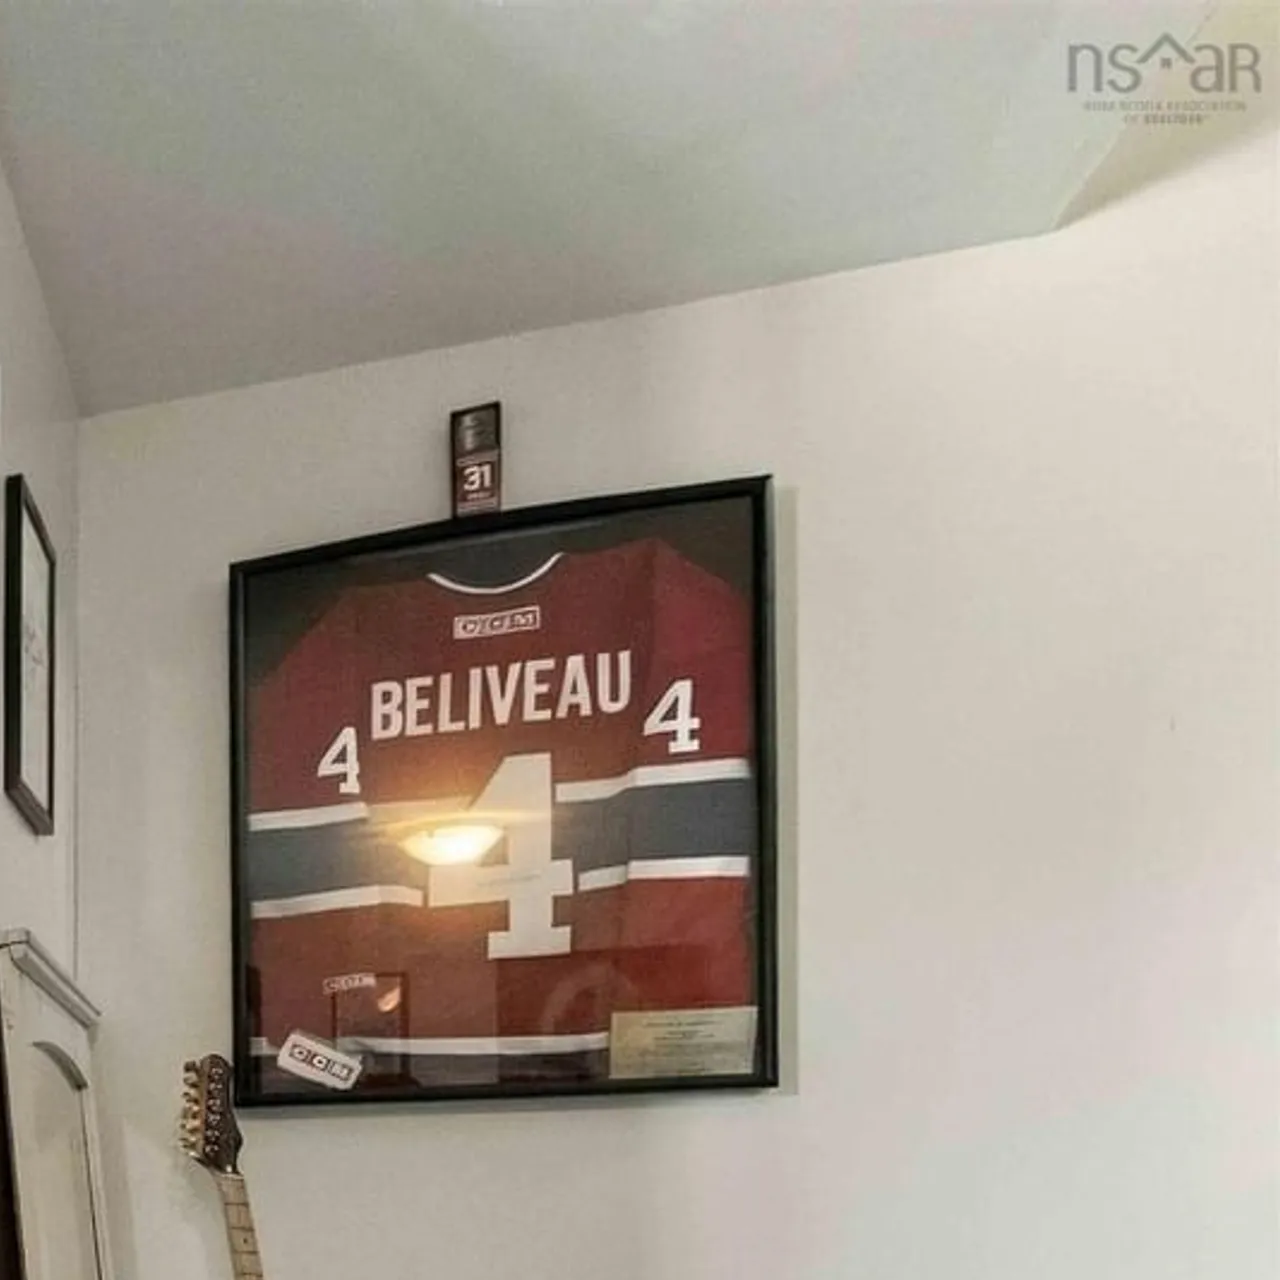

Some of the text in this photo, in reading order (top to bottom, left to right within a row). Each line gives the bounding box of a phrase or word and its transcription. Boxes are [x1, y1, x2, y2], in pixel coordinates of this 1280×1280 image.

[463, 463, 492, 491] 31
[370, 650, 632, 741] BELIVEAU
[643, 679, 701, 753] 4
[317, 726, 361, 794] 4
[427, 752, 574, 960] 4
